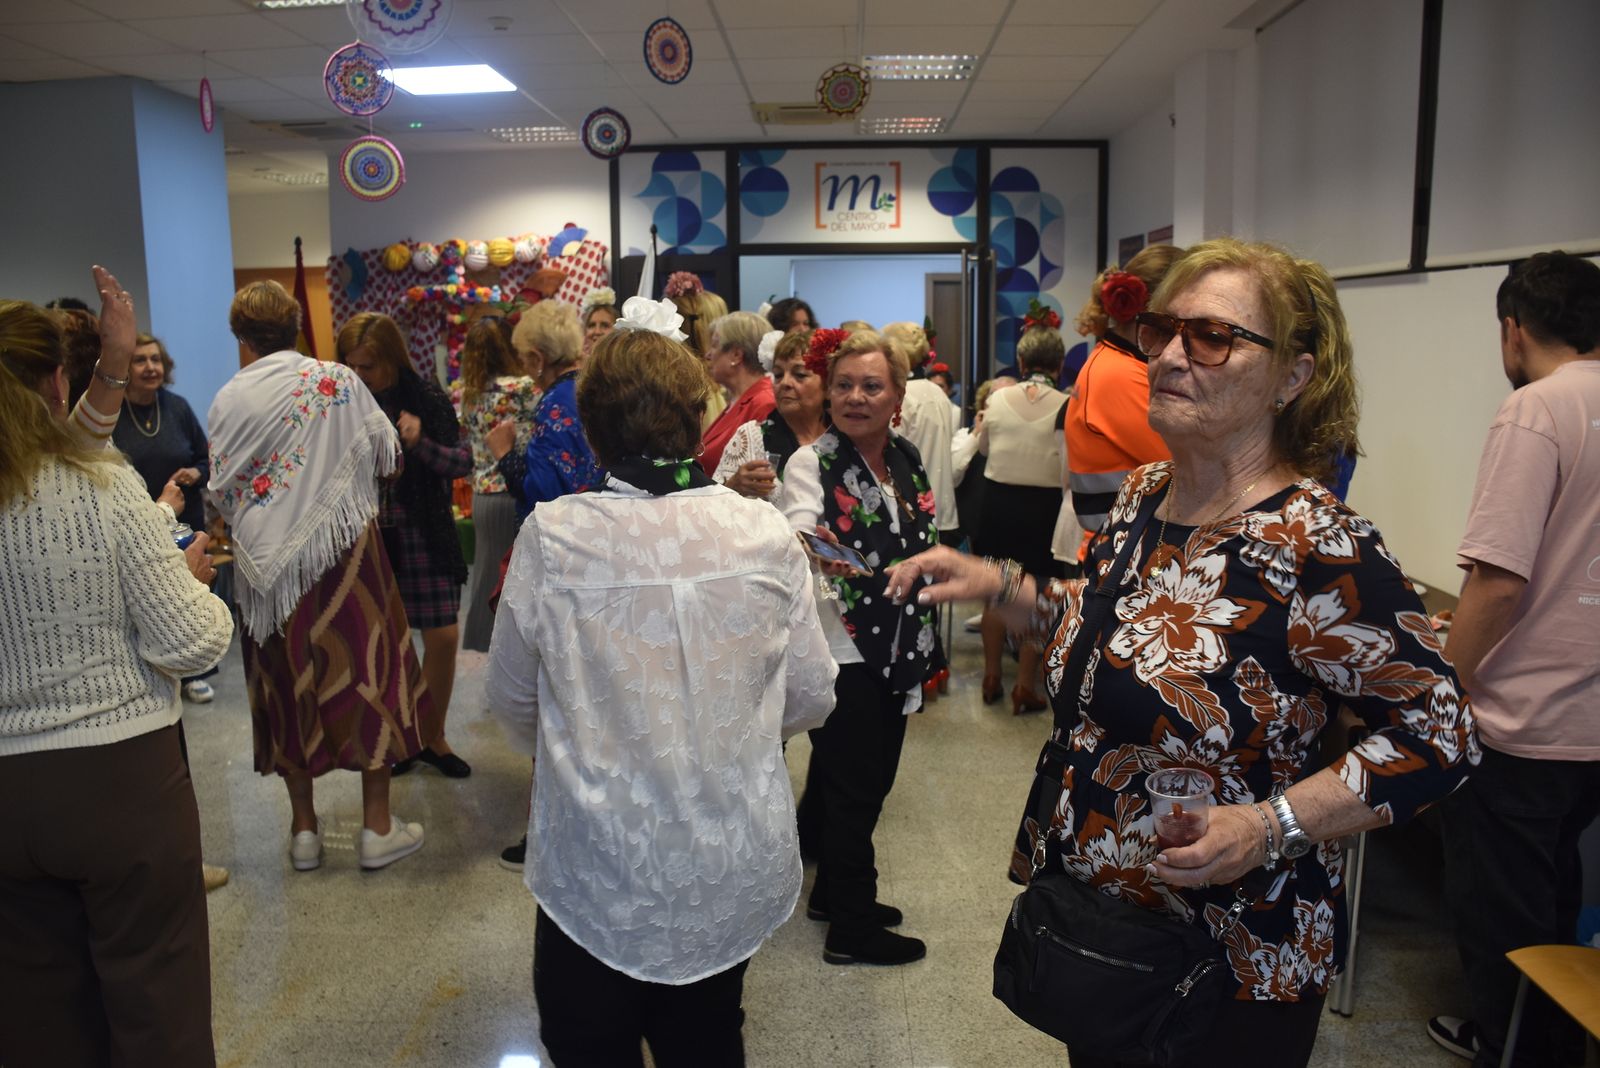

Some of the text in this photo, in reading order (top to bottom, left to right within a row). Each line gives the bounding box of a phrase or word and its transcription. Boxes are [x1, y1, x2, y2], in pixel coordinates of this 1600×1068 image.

[822, 174, 881, 211] m
[837, 211, 877, 221] CENTRO
[831, 222, 886, 232] DEL MAYOR
